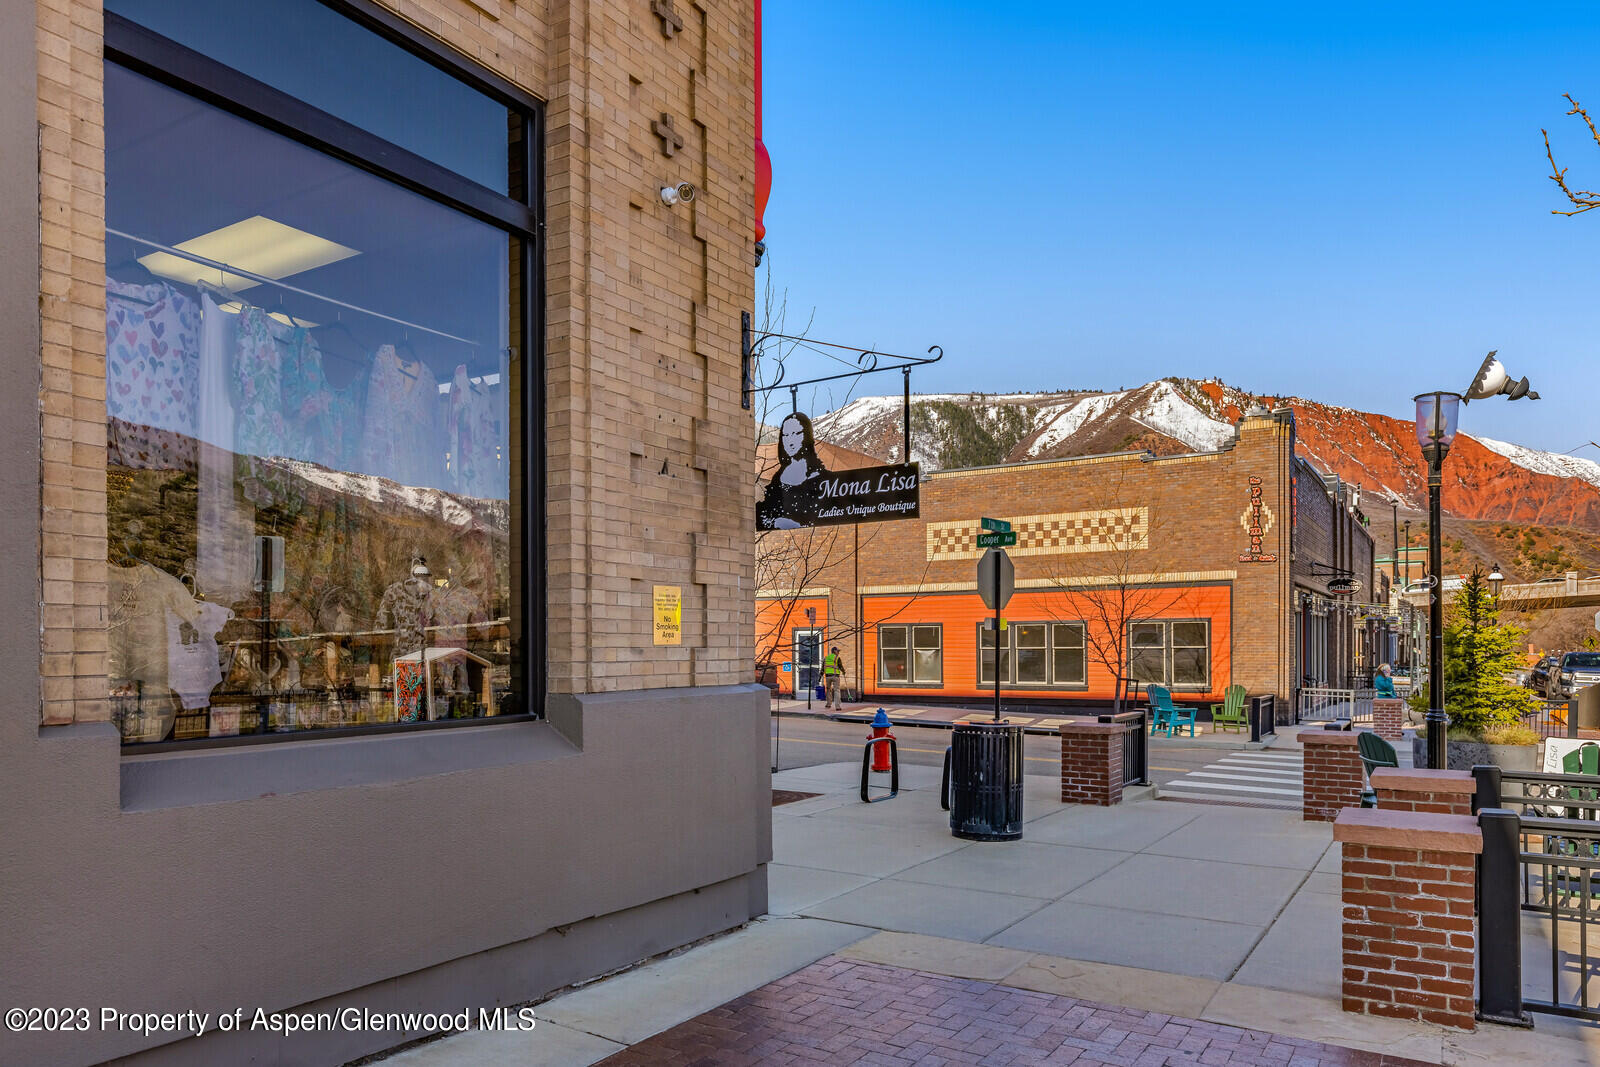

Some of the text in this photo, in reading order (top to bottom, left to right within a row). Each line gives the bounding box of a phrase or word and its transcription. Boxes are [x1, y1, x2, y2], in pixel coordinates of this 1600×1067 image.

[818, 470, 916, 499] Mona Lisa
[818, 500, 916, 518] Ladies Unique Boutique
[980, 535, 999, 545] Cooper
[1329, 584, 1360, 592] pullman
[663, 615, 672, 623] No
[656, 622, 679, 632] Smoking
